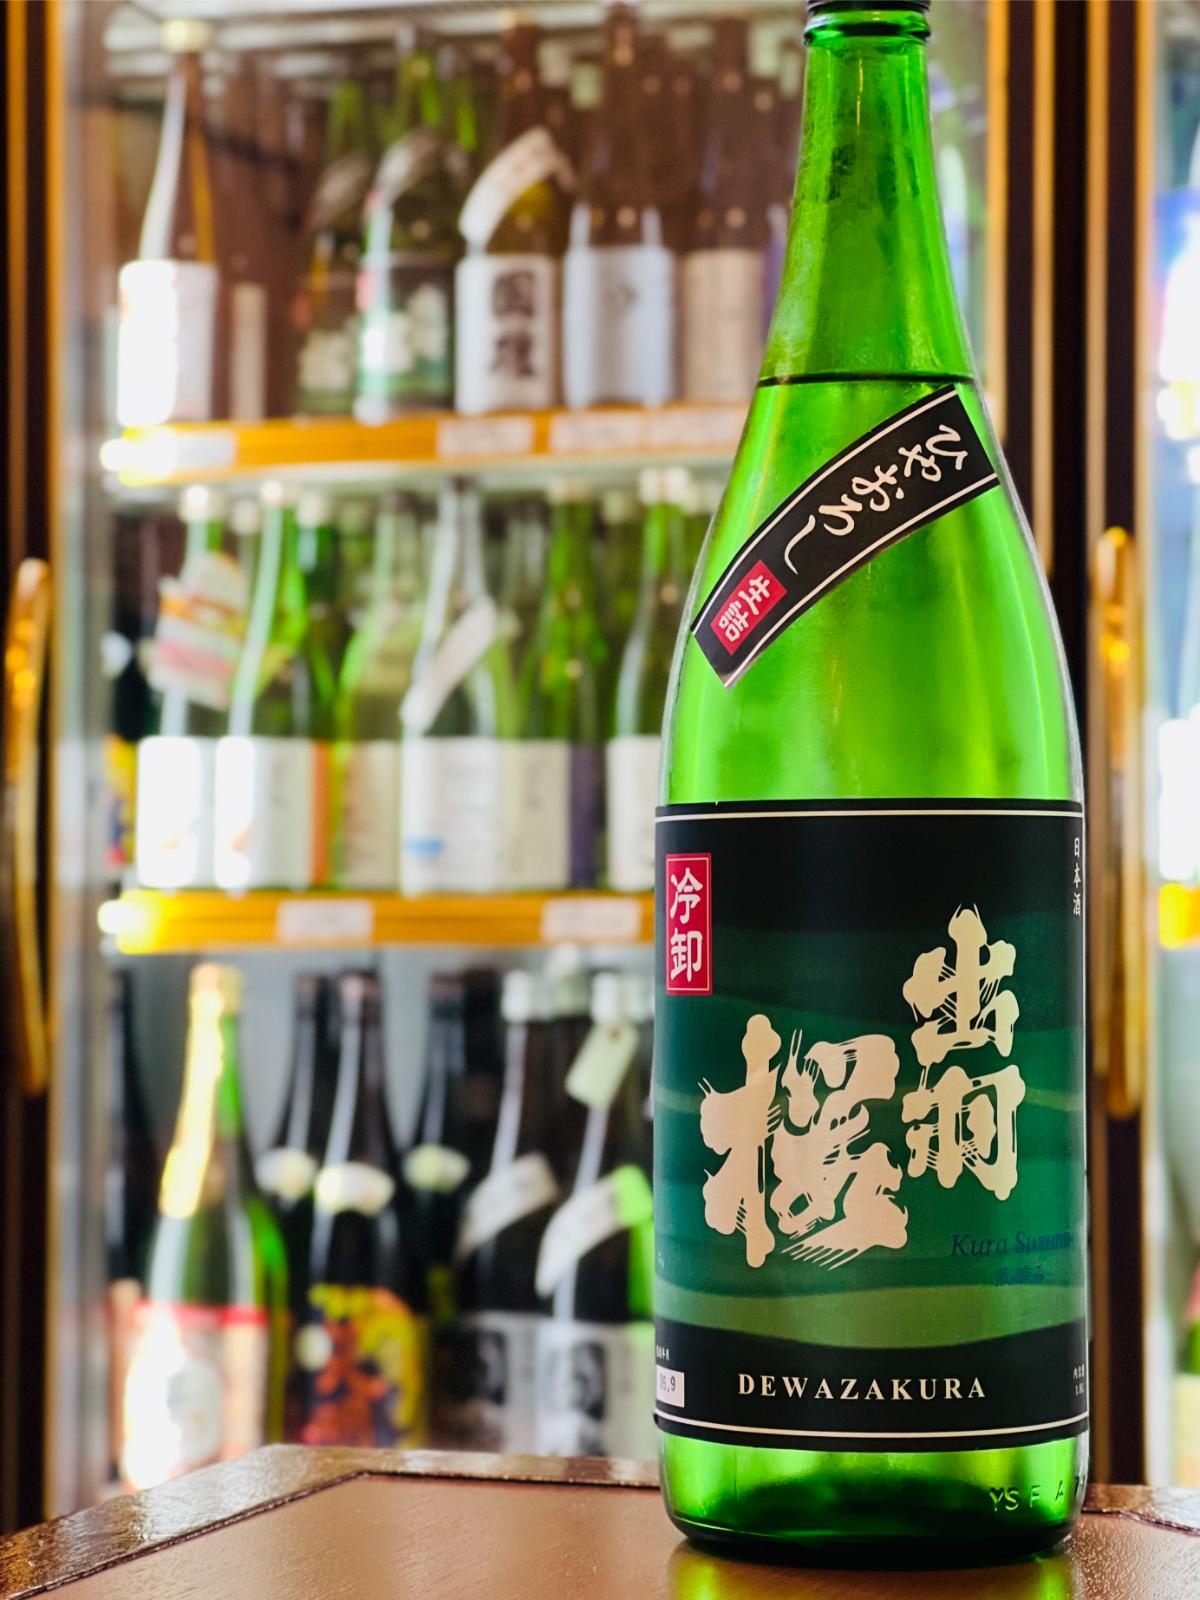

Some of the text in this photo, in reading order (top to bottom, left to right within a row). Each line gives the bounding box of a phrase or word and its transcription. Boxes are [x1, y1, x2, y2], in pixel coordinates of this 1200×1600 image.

[784, 424, 968, 575] ひやおろし
[717, 575, 771, 643] 生詰
[669, 867, 704, 983] 冷卸
[951, 1233, 1009, 1257] Kura
[737, 1372, 987, 1401] DEWAZAKURA
